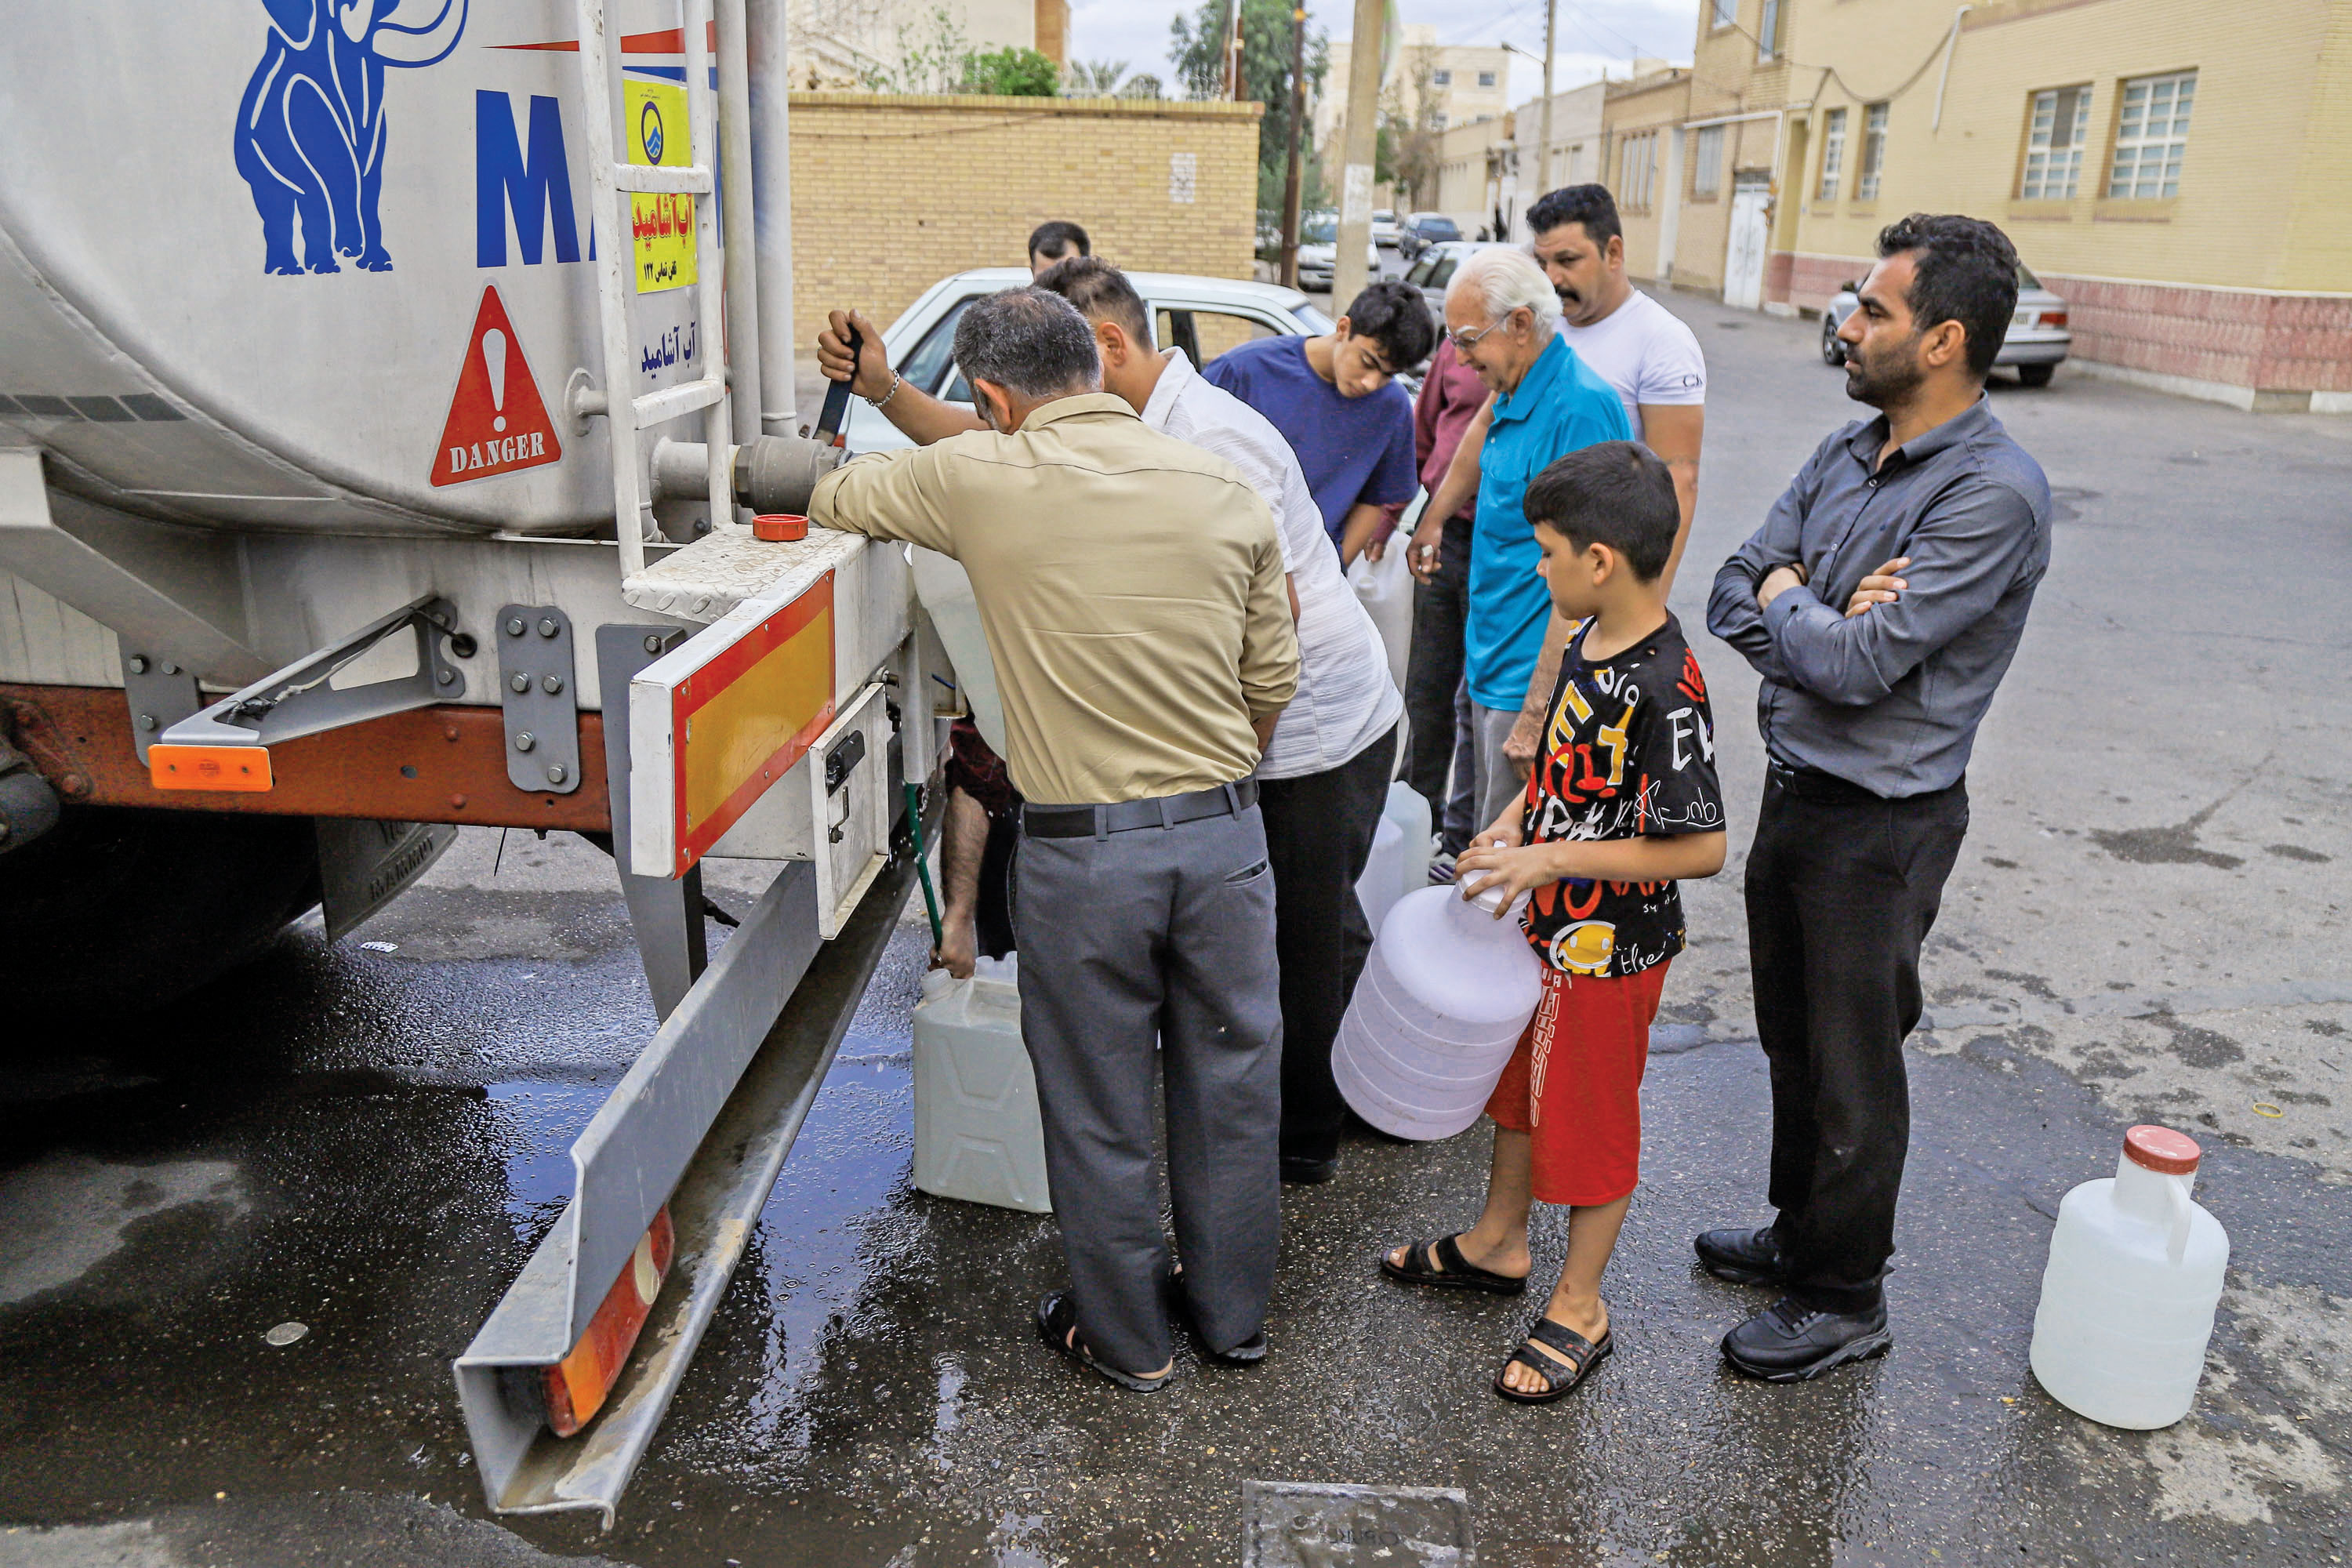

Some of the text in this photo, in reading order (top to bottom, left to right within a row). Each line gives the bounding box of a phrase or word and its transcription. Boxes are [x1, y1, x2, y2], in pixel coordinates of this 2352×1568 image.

[632, 193, 677, 252] آشامید
[641, 321, 696, 379] آب آشامید
[449, 432, 546, 474] DANGER
